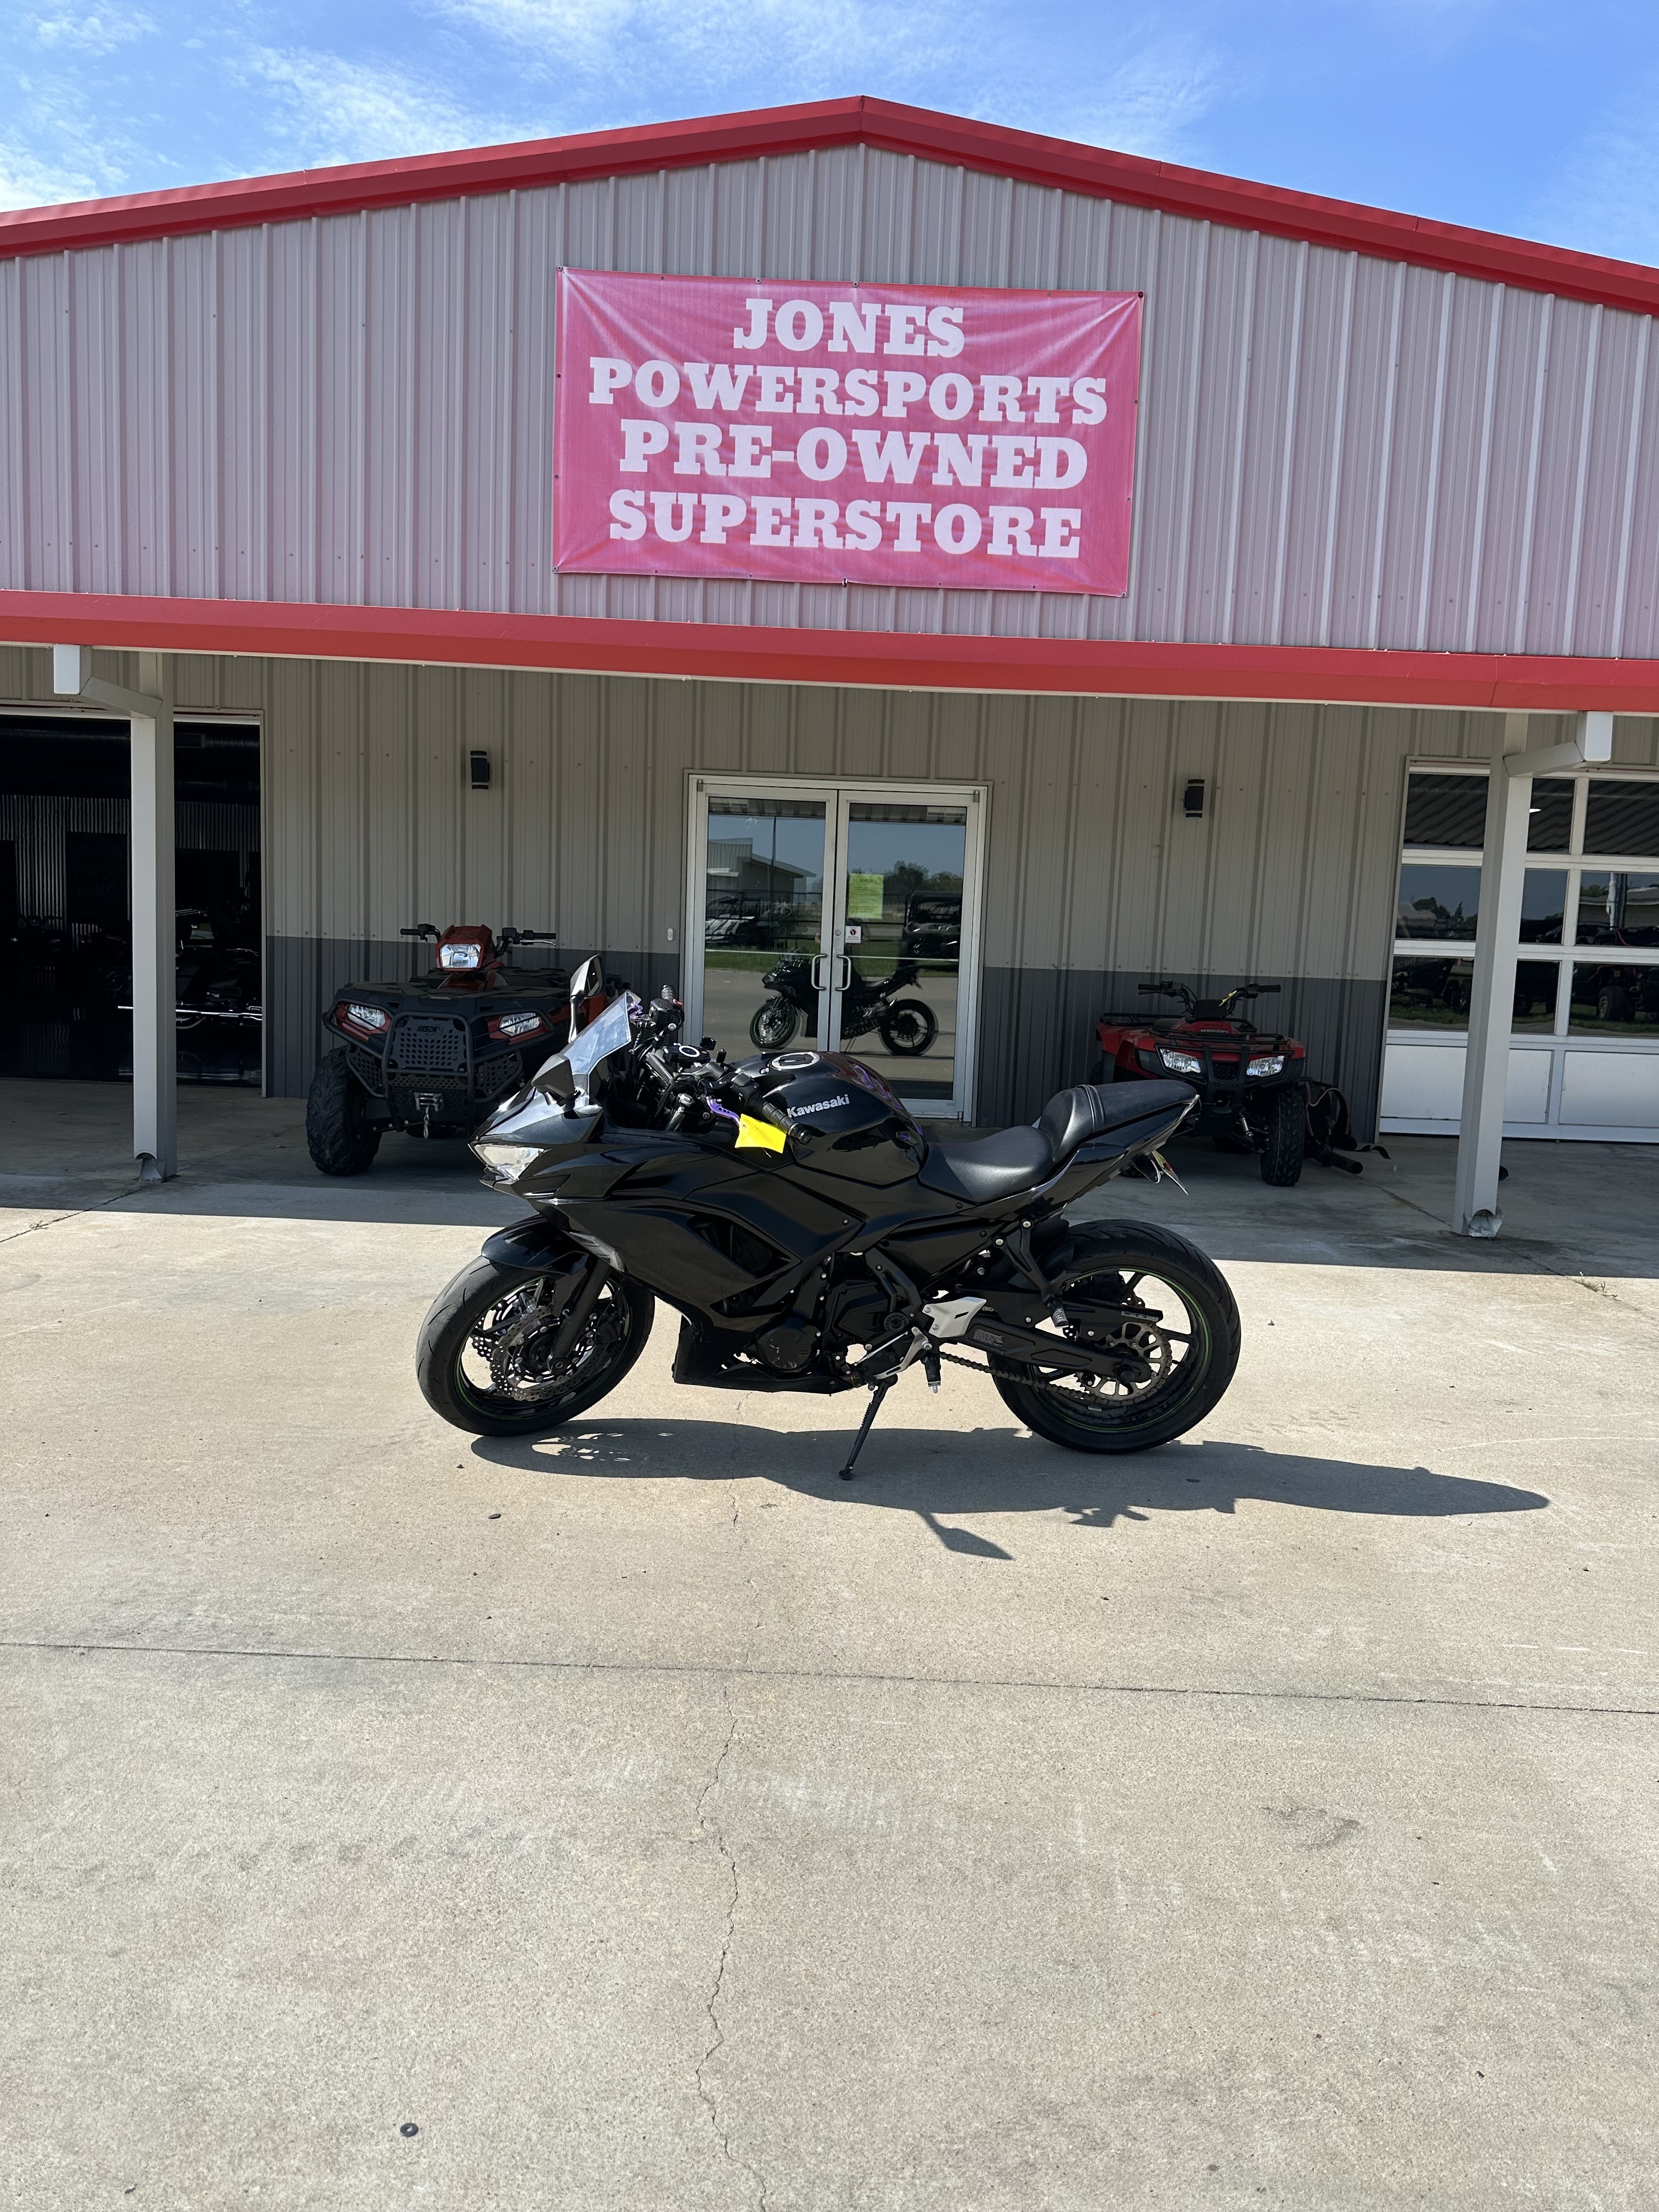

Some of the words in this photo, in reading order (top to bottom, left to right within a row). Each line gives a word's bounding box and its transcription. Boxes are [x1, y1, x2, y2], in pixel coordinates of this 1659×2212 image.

[733, 298, 964, 358] JONES
[589, 357, 1108, 425] POWERSPORTS
[619, 419, 1088, 490] PRE-OWNED
[610, 489, 1081, 558] SUPERSTORE
[787, 1094, 850, 1118] Kawasaki
